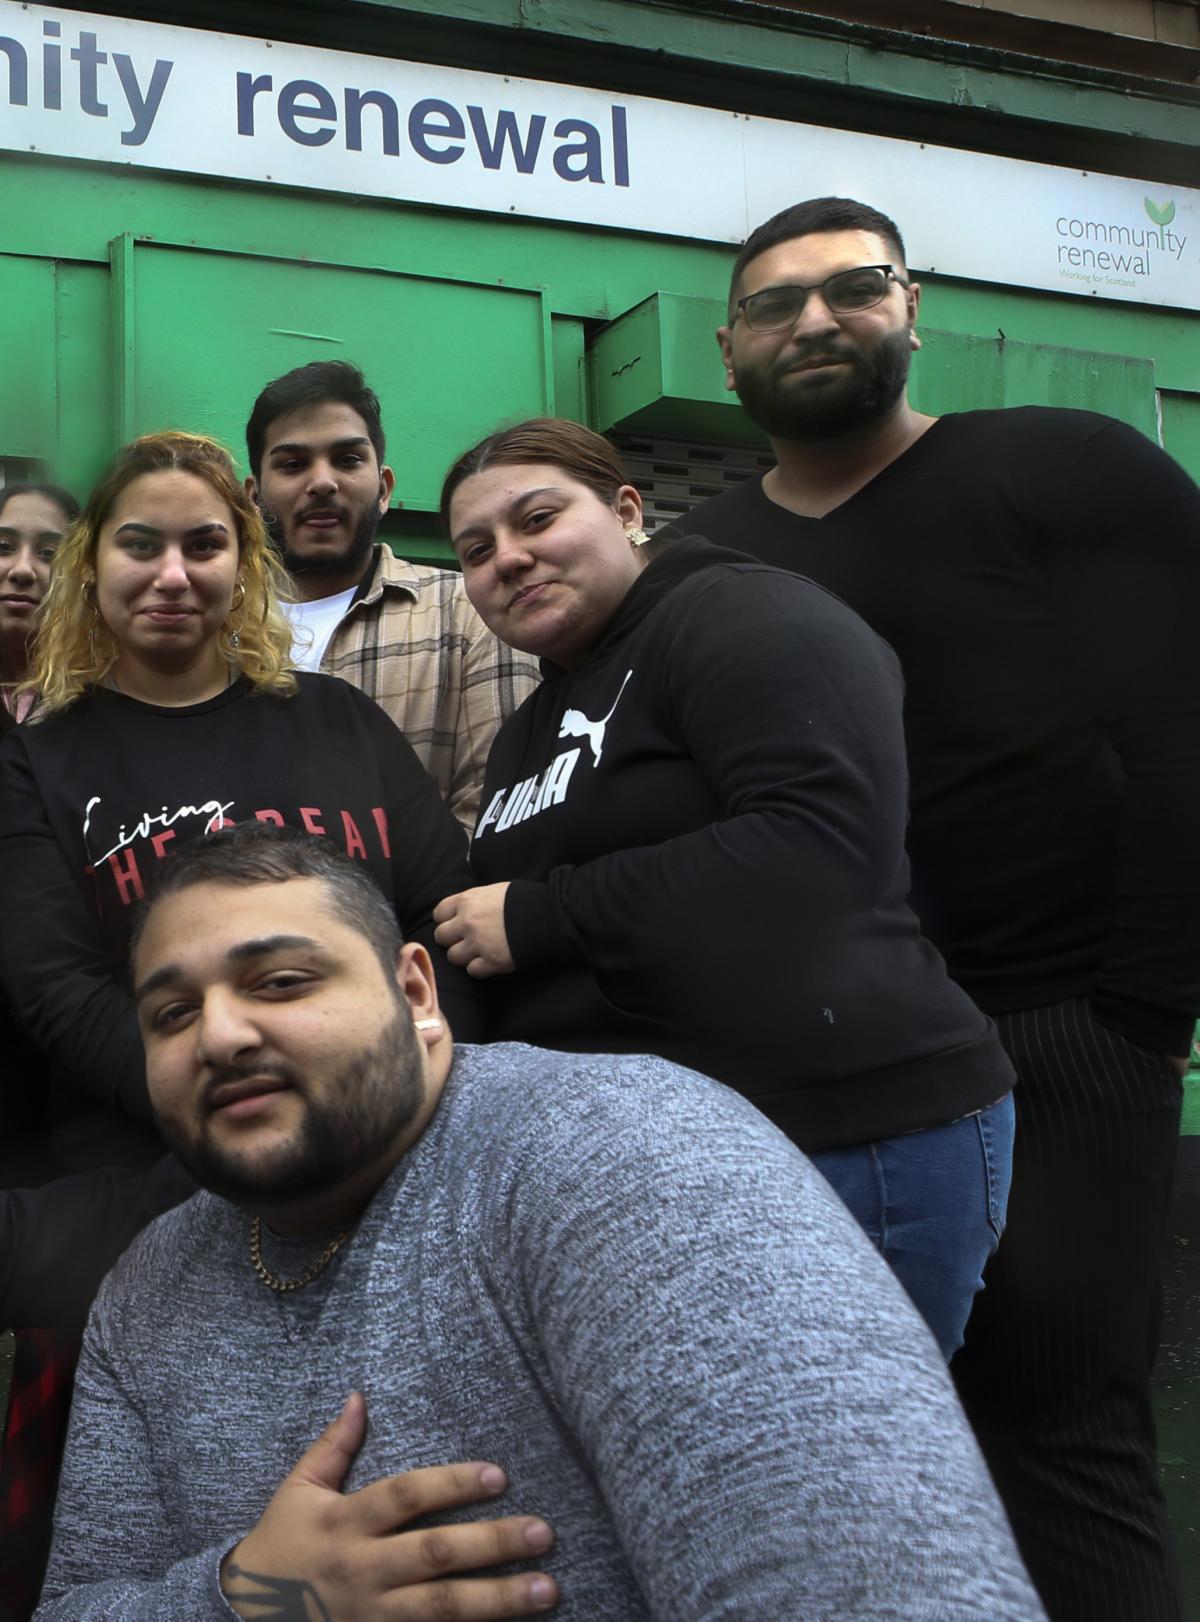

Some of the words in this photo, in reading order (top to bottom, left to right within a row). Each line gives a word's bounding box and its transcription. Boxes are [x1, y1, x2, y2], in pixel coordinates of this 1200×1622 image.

[236, 71, 630, 188] renewal
[1056, 217, 1187, 260] community
[1057, 245, 1151, 275] renewal
[1059, 269, 1091, 283] Working
[1105, 275, 1136, 287] Scotland
[474, 748, 582, 840] PUMA
[82, 796, 235, 868] Living
